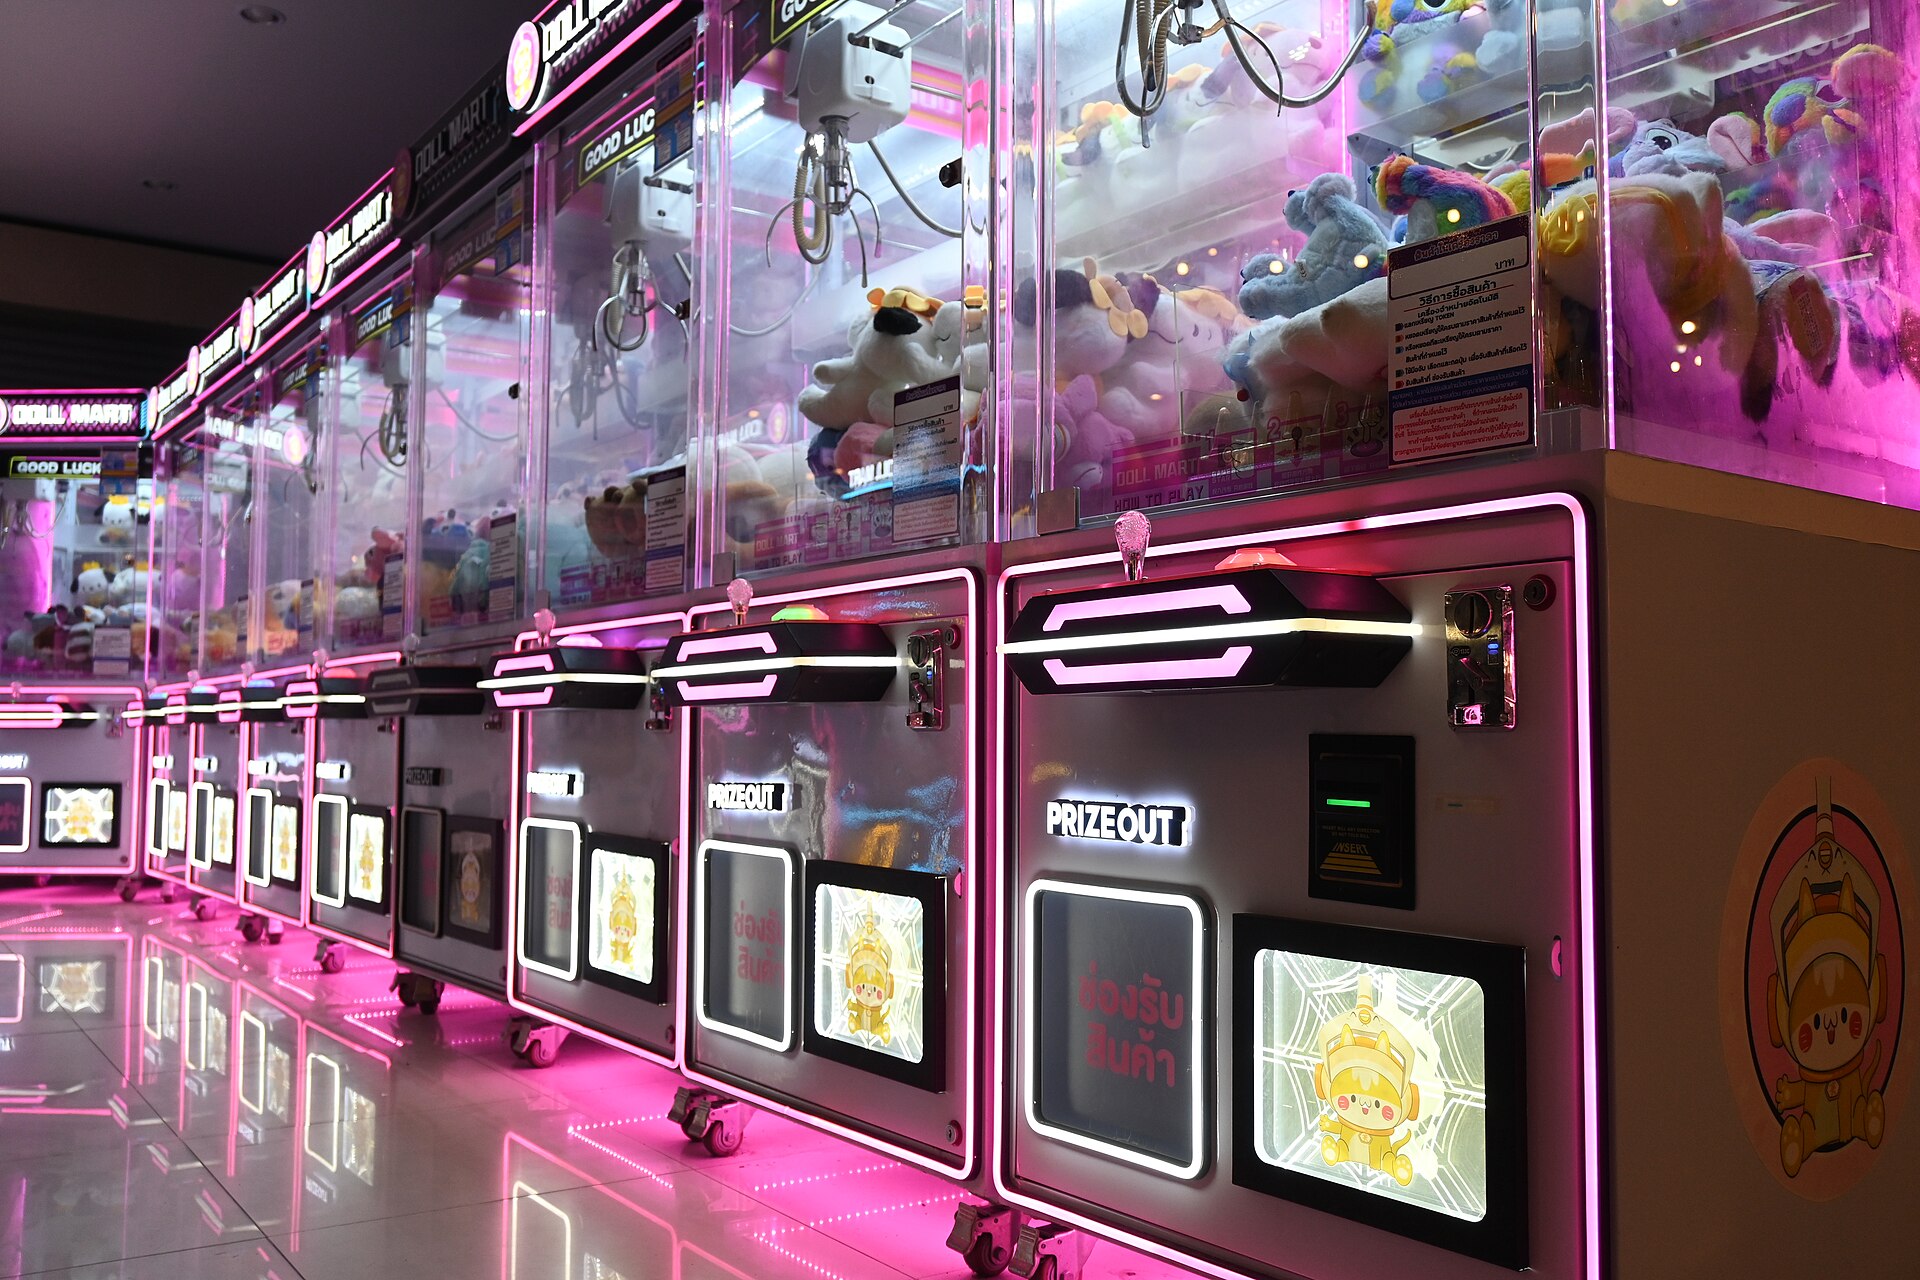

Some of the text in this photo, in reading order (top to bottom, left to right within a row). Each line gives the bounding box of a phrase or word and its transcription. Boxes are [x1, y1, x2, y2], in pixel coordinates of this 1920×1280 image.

[415, 88, 488, 181] DOLL MART
[585, 131, 621, 171] GOOD
[1495, 258, 1515, 270] บาท
[1419, 279, 1497, 306] วิธีการซื้อสินค้า
[1435, 312, 1455, 321] TOKEN
[12, 403, 133, 425] DOLL MART
[1267, 416, 1281, 441] 2
[17, 461, 58, 474] GOOD
[1116, 458, 1198, 487] DOLL MART
[1146, 493, 1162, 507] TO
[1168, 485, 1204, 504] PLAY
[834, 505, 842, 522] 2
[1332, 842, 1369, 855] INSERT
[1078, 960, 1184, 1031] ช่องรับ
[1086, 1021, 1176, 1088] สินค้า
